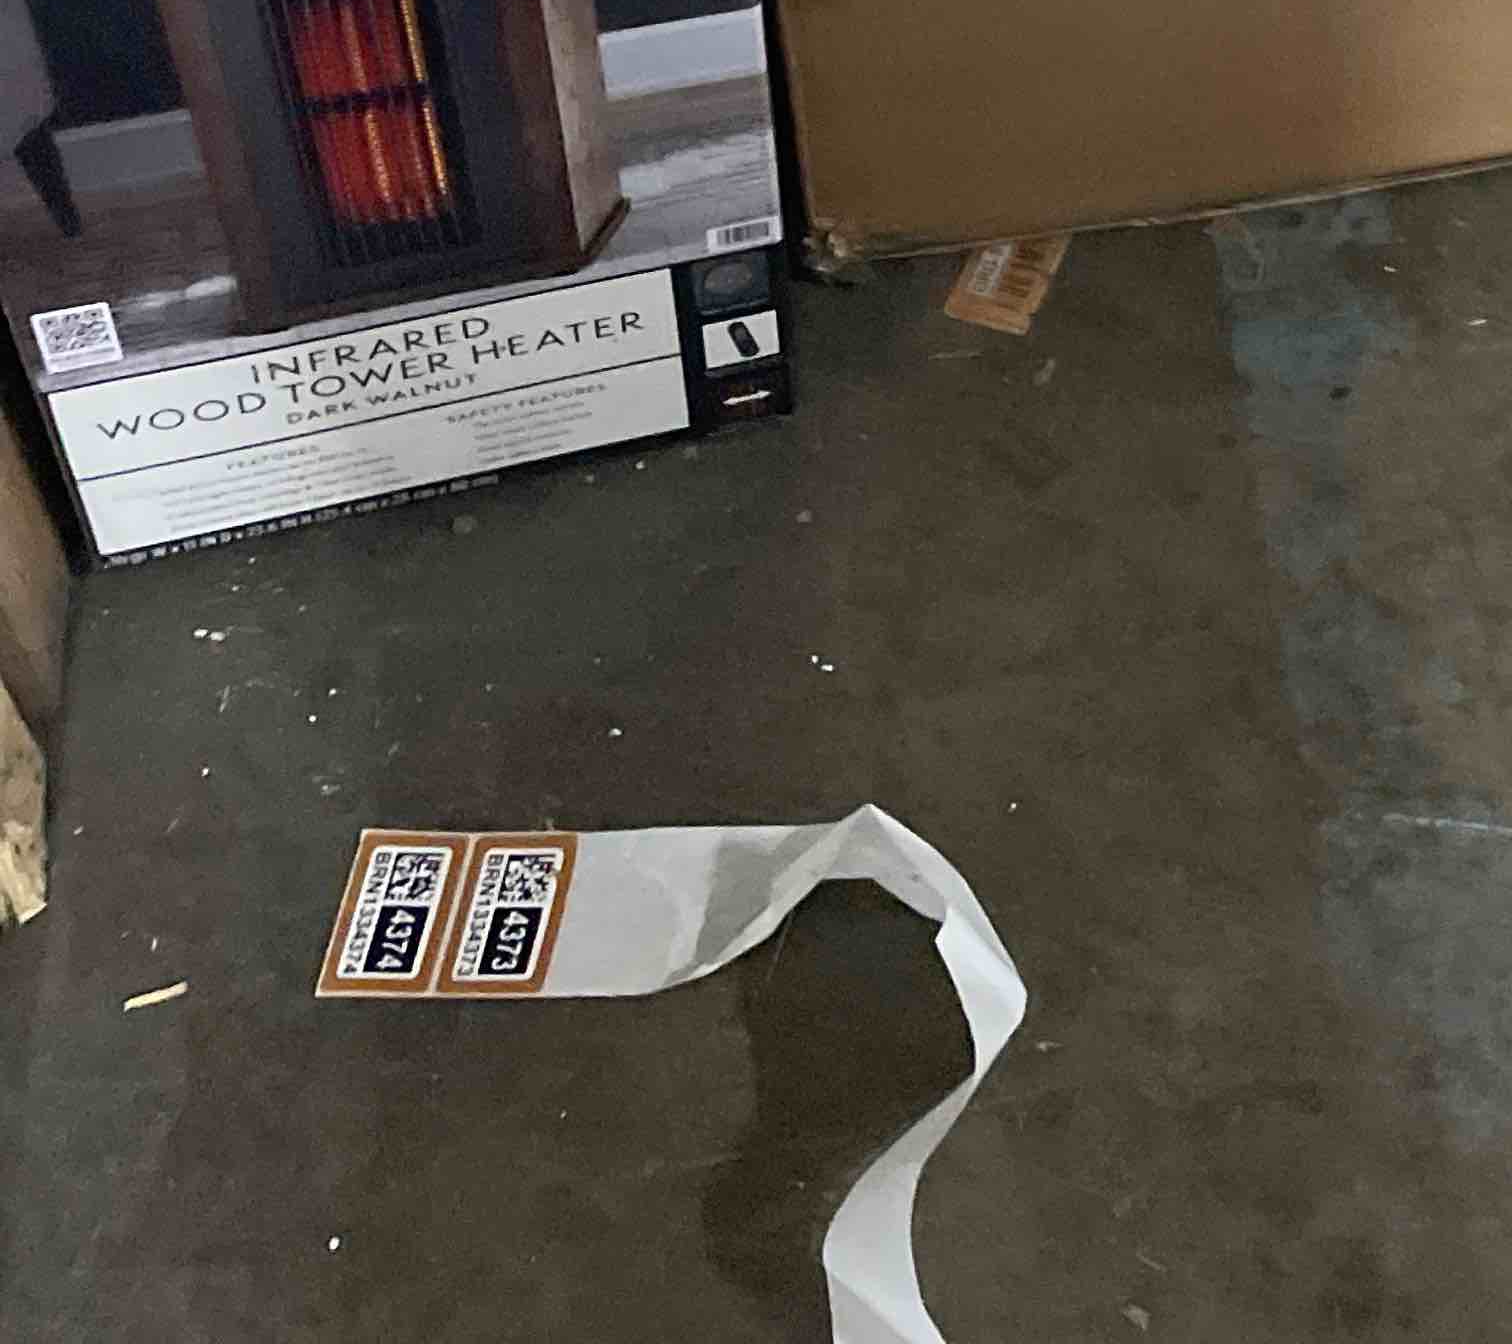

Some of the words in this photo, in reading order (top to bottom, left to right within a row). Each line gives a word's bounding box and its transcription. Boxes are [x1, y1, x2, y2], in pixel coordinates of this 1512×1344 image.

[96, 388, 268, 441] WOOD
[286, 353, 455, 405] TOWER
[471, 310, 645, 366] HEATER
[251, 316, 491, 385] INFRARED
[286, 400, 358, 427] DARK
[365, 373, 478, 408] WALNUT
[341, 851, 392, 975] BRN1334374
[375, 907, 416, 970] 4374
[456, 853, 504, 977] BRN1334373
[490, 909, 530, 972] 4373
